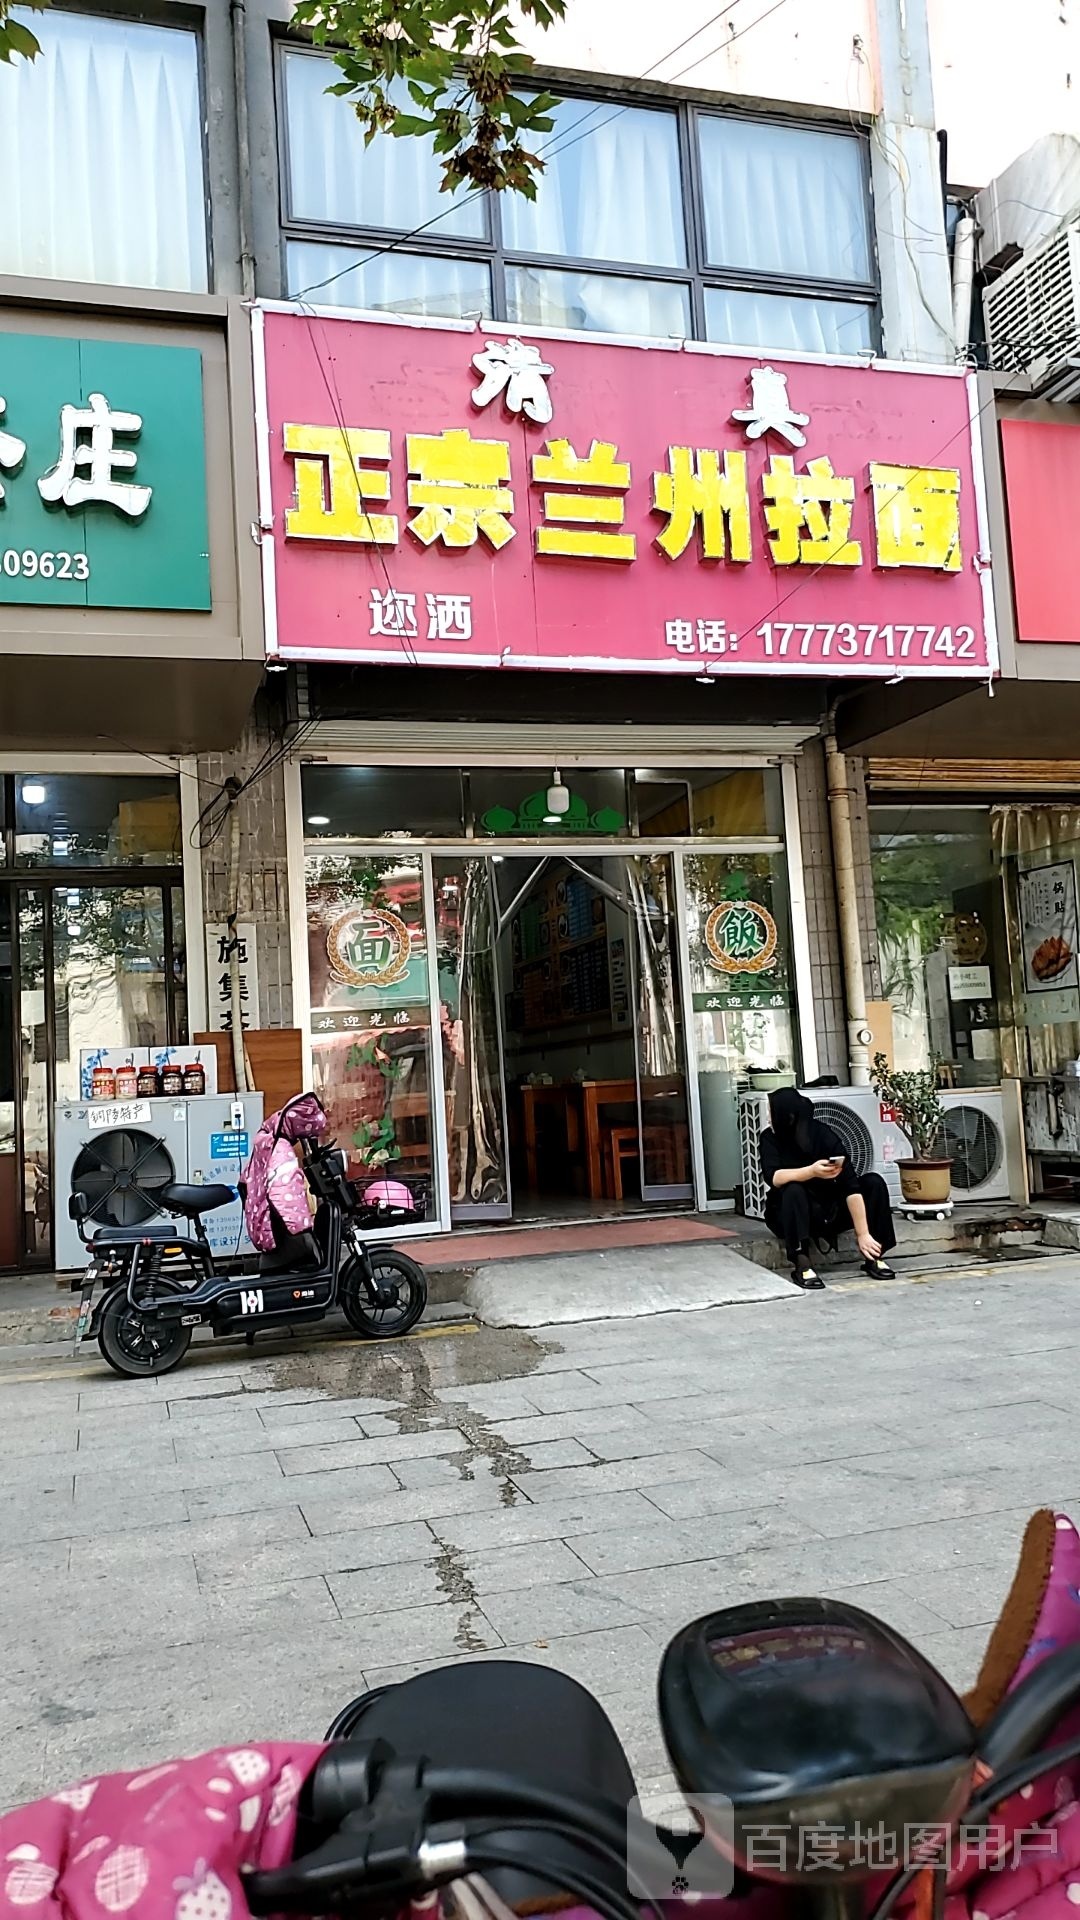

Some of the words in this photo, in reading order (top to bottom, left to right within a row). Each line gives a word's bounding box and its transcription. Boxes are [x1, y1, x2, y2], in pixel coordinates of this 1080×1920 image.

[0, 393, 153, 516] 庄
[283, 422, 963, 573] 正宗兰州拉面
[0, 549, 90, 580] 09623
[756, 621, 977, 658] 17773717742
[346, 919, 393, 972] 面
[317, 1010, 411, 1029] 欢迎光临
[706, 994, 785, 1008] 欢迎光临
